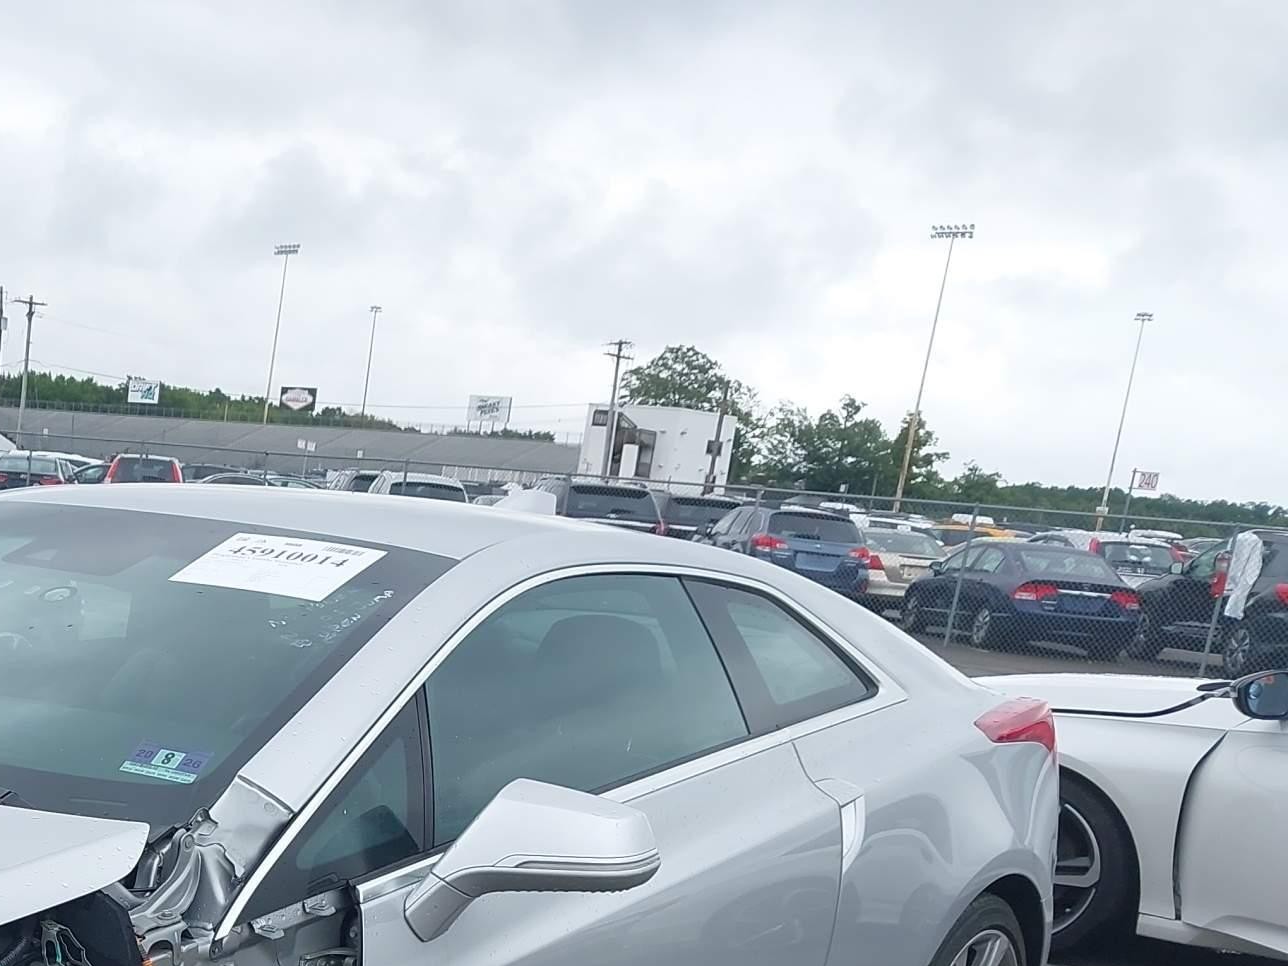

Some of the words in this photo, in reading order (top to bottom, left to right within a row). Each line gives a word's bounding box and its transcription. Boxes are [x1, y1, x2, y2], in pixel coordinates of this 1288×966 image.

[1138, 473, 1159, 489] 240
[228, 545, 350, 568] 45910014
[161, 752, 175, 765] 8
